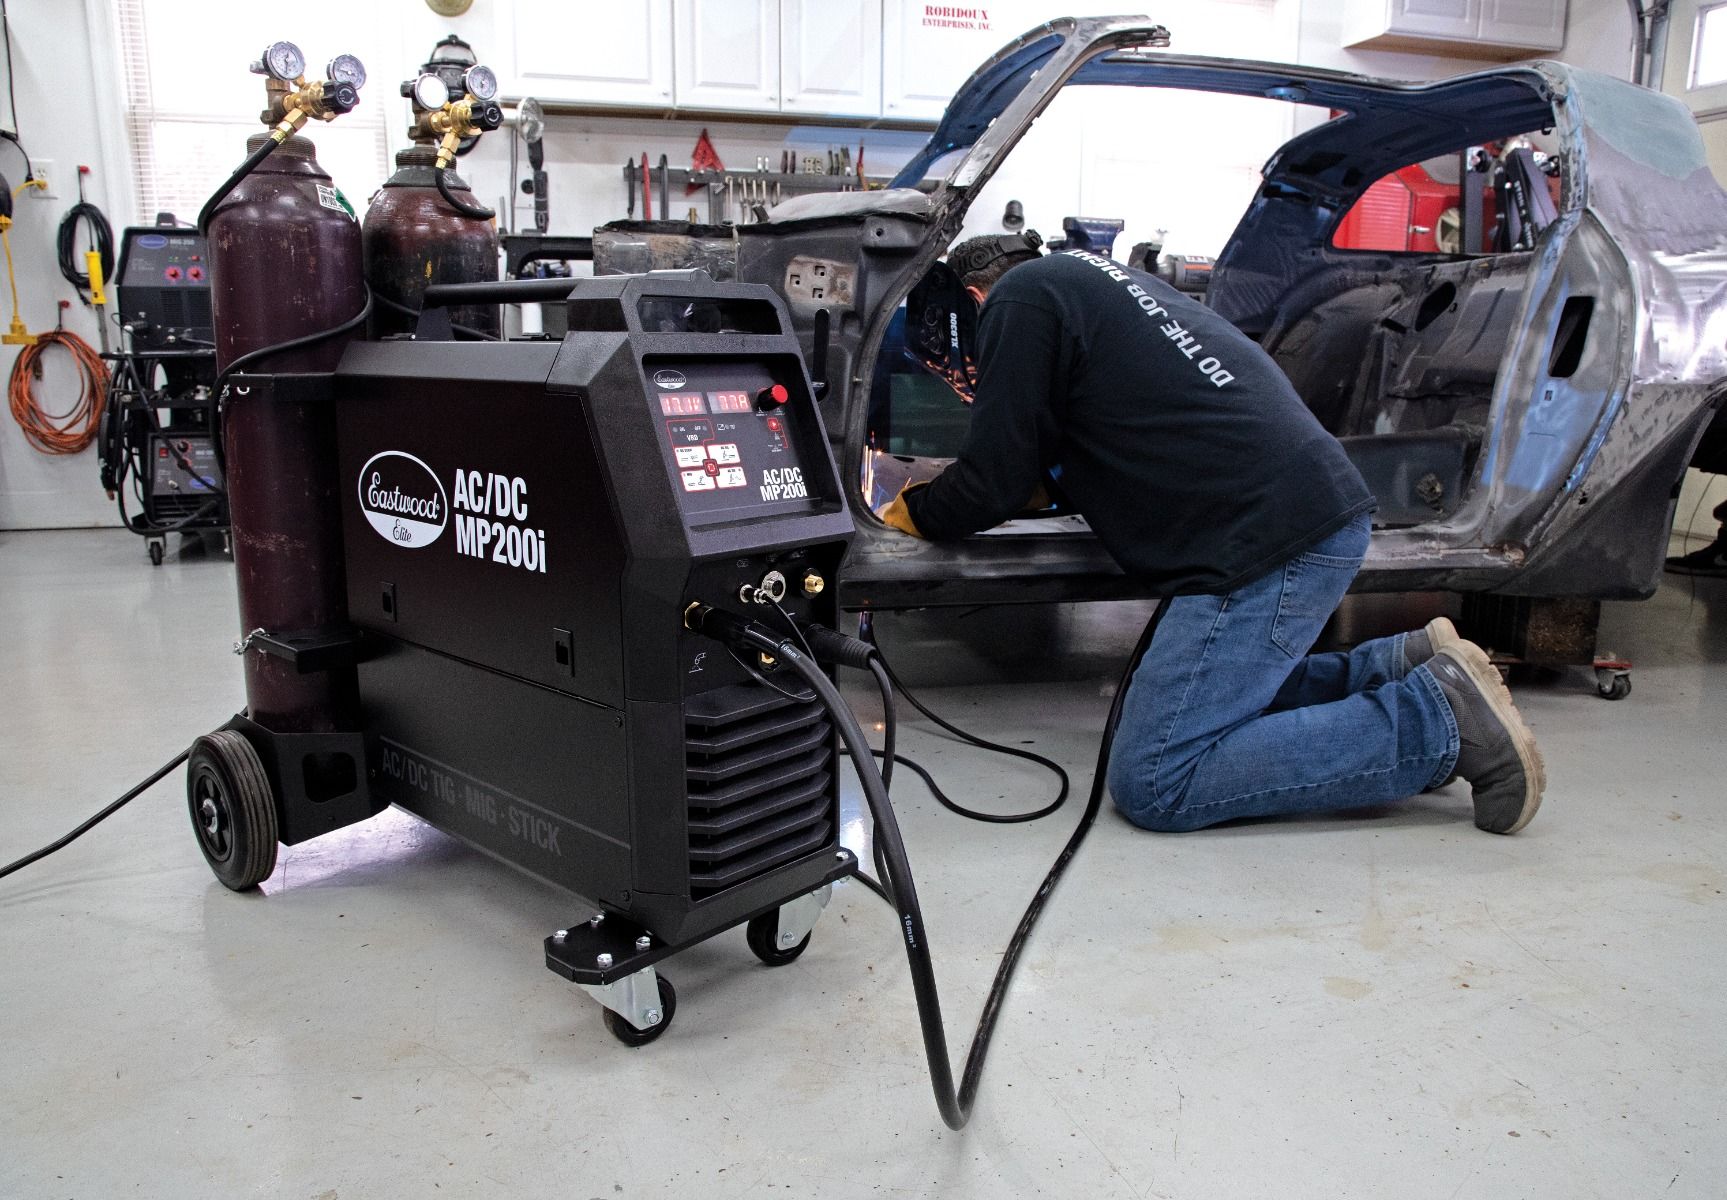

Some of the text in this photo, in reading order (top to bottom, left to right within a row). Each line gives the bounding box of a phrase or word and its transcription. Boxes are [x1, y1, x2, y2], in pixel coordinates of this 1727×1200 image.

[925, 5, 988, 20] ROBIDOUX
[1061, 249, 1235, 388] DO THE JOB RIGHT
[367, 471, 438, 520] Eastwood
[453, 468, 528, 521] AC/DC
[759, 482, 808, 502] MP200i
[763, 467, 803, 486] AC/DC
[392, 518, 412, 543] Elite
[455, 513, 546, 573] MP200i
[382, 747, 562, 857] AC/DC TIG MIG STICK
